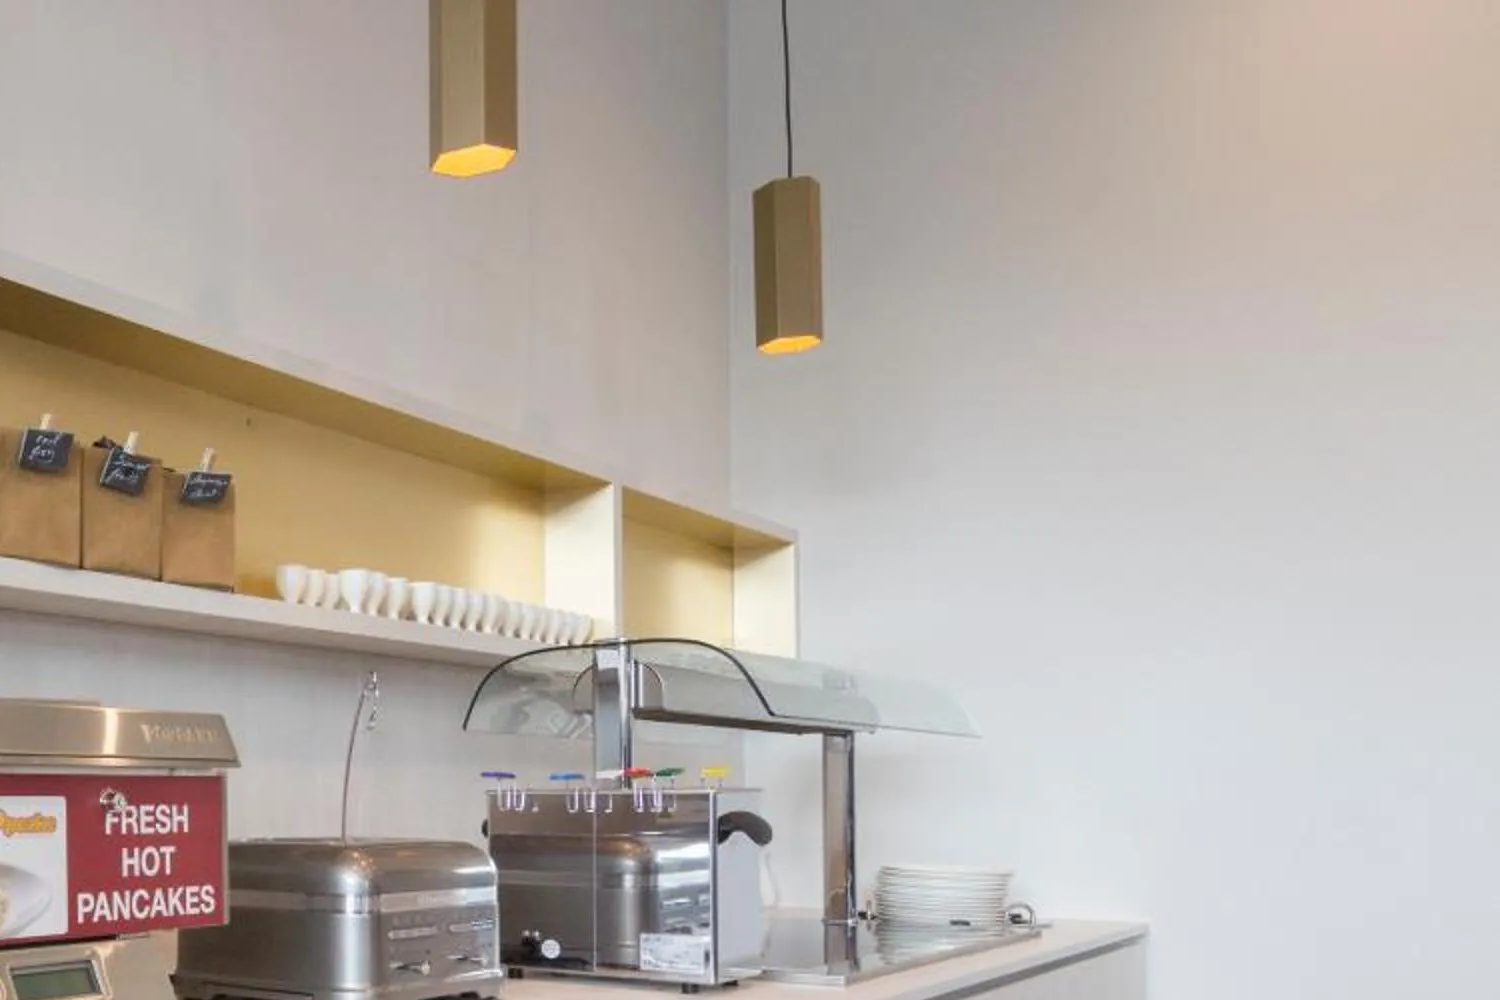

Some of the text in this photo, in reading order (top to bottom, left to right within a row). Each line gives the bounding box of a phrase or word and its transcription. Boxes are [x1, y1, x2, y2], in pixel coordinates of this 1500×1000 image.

[105, 803, 189, 835] FRESH
[121, 845, 176, 878] HOT
[77, 884, 216, 924] PANCAKES
